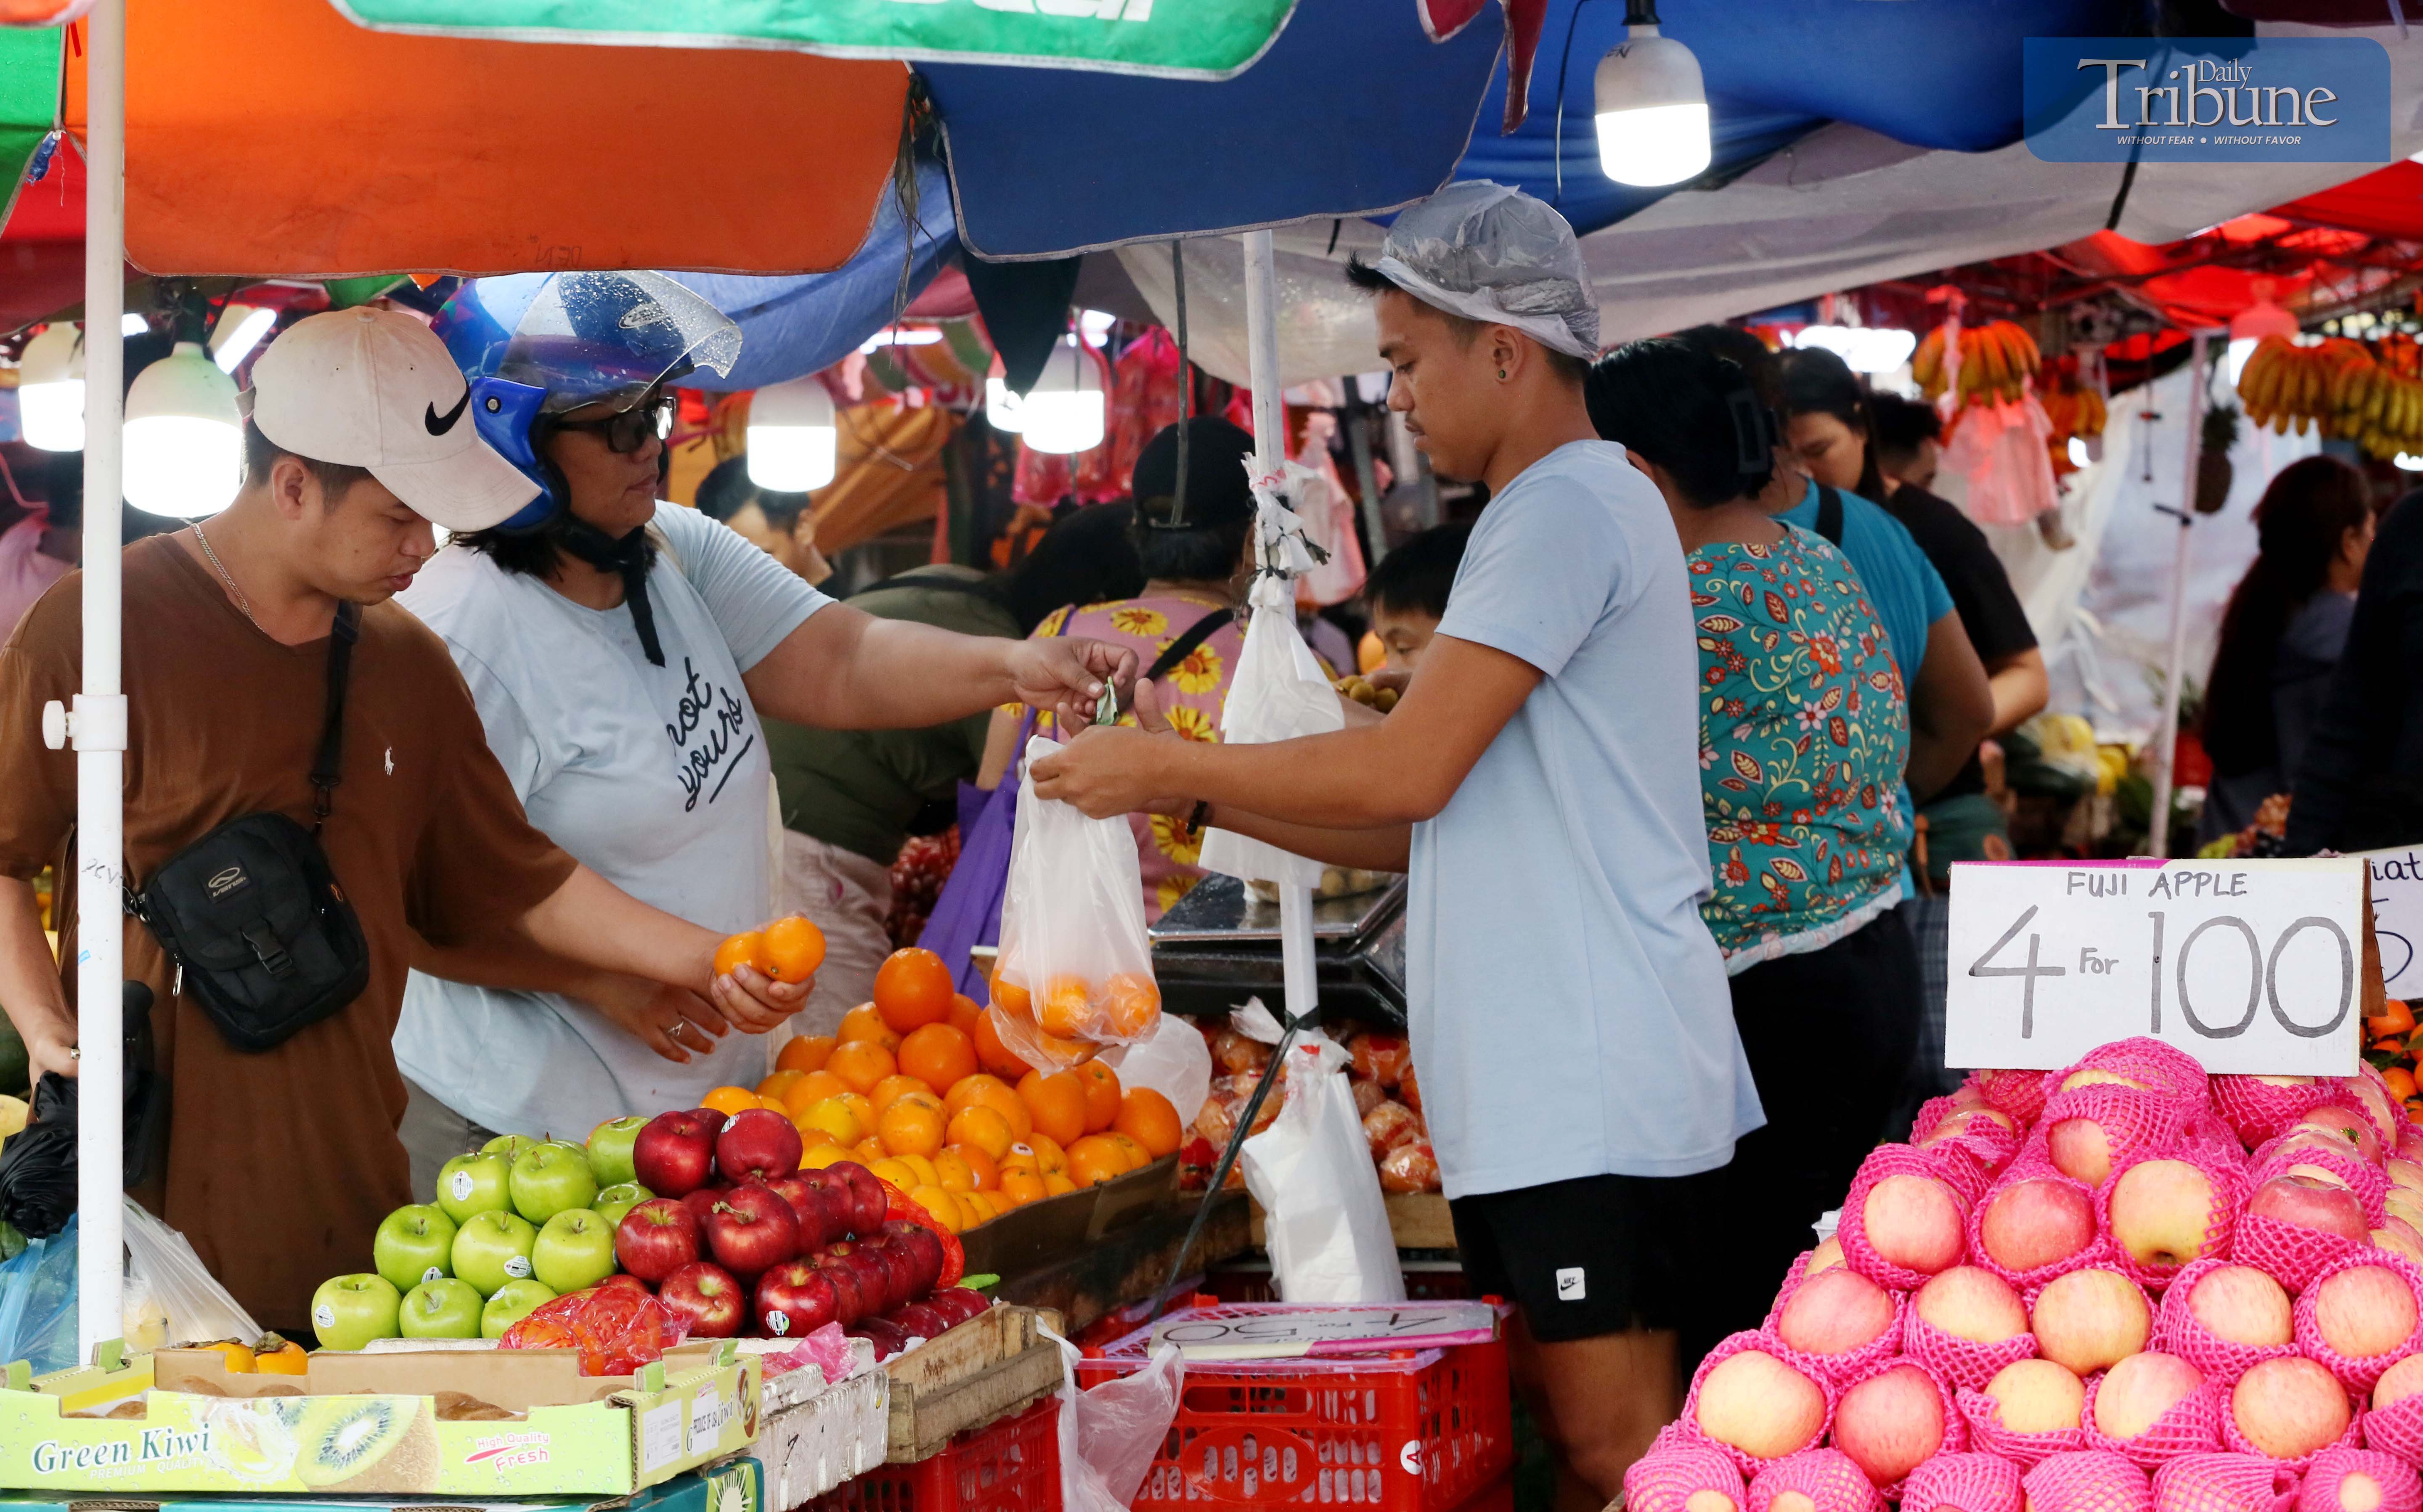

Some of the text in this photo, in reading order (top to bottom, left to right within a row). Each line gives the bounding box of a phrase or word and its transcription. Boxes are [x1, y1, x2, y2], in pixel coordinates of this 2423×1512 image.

[667, 657, 712, 757] not
[678, 687, 743, 812] yours
[2066, 871, 2247, 900] FUJI APPLE
[1968, 904, 2354, 1039] 4 For 100
[1162, 1319, 1325, 1342] 50
[1365, 1313, 1447, 1330] 4
[33, 1423, 210, 1472] Green Kiwi
[478, 1433, 549, 1448] High Quality
[89, 1456, 205, 1480] PREMIUM QUALITY
[496, 1447, 548, 1472] Fresh
